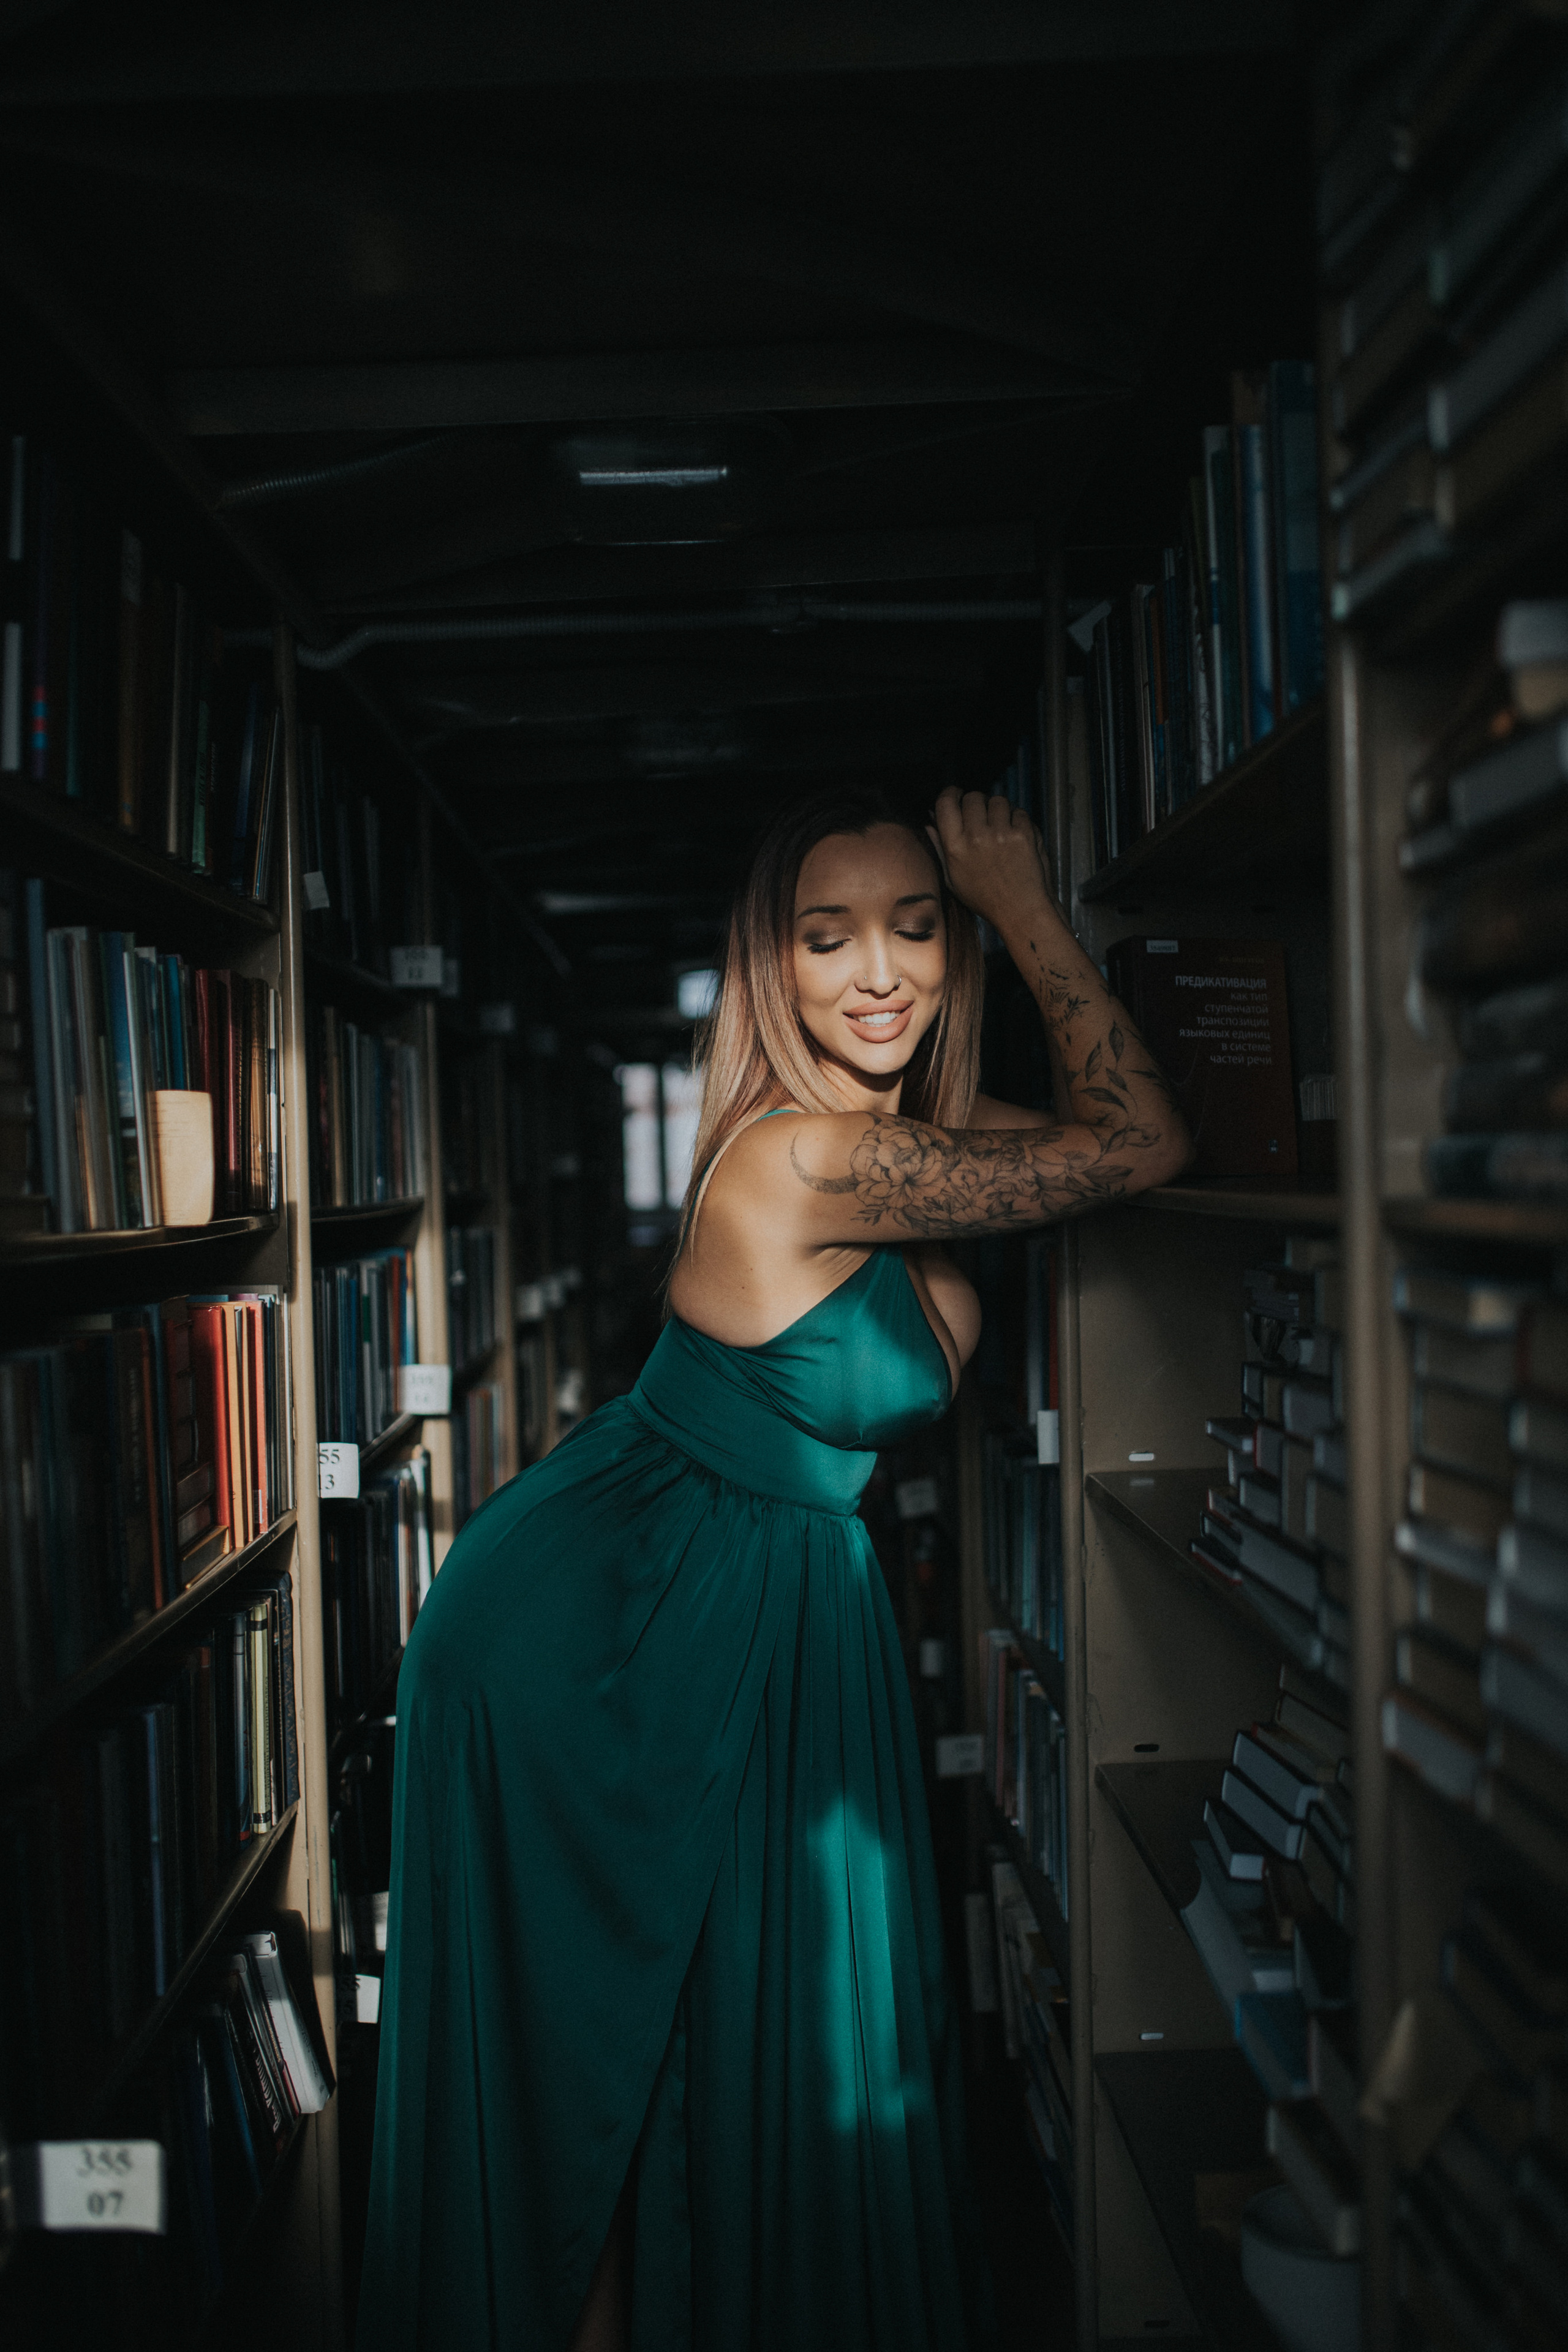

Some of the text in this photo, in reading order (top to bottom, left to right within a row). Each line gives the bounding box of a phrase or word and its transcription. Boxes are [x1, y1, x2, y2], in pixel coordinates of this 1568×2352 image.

[1175, 975, 1266, 989] ПРЕДИКАТИВАЦИЯ
[1205, 1003, 1268, 1014] ступенчатой
[1196, 1016, 1269, 1027] транспозиции
[1179, 1028, 1270, 1040] языковых единиц
[1230, 1043, 1271, 1052] системе
[1210, 1054, 1272, 1066] частей речи
[87, 2190, 123, 2217] 07
